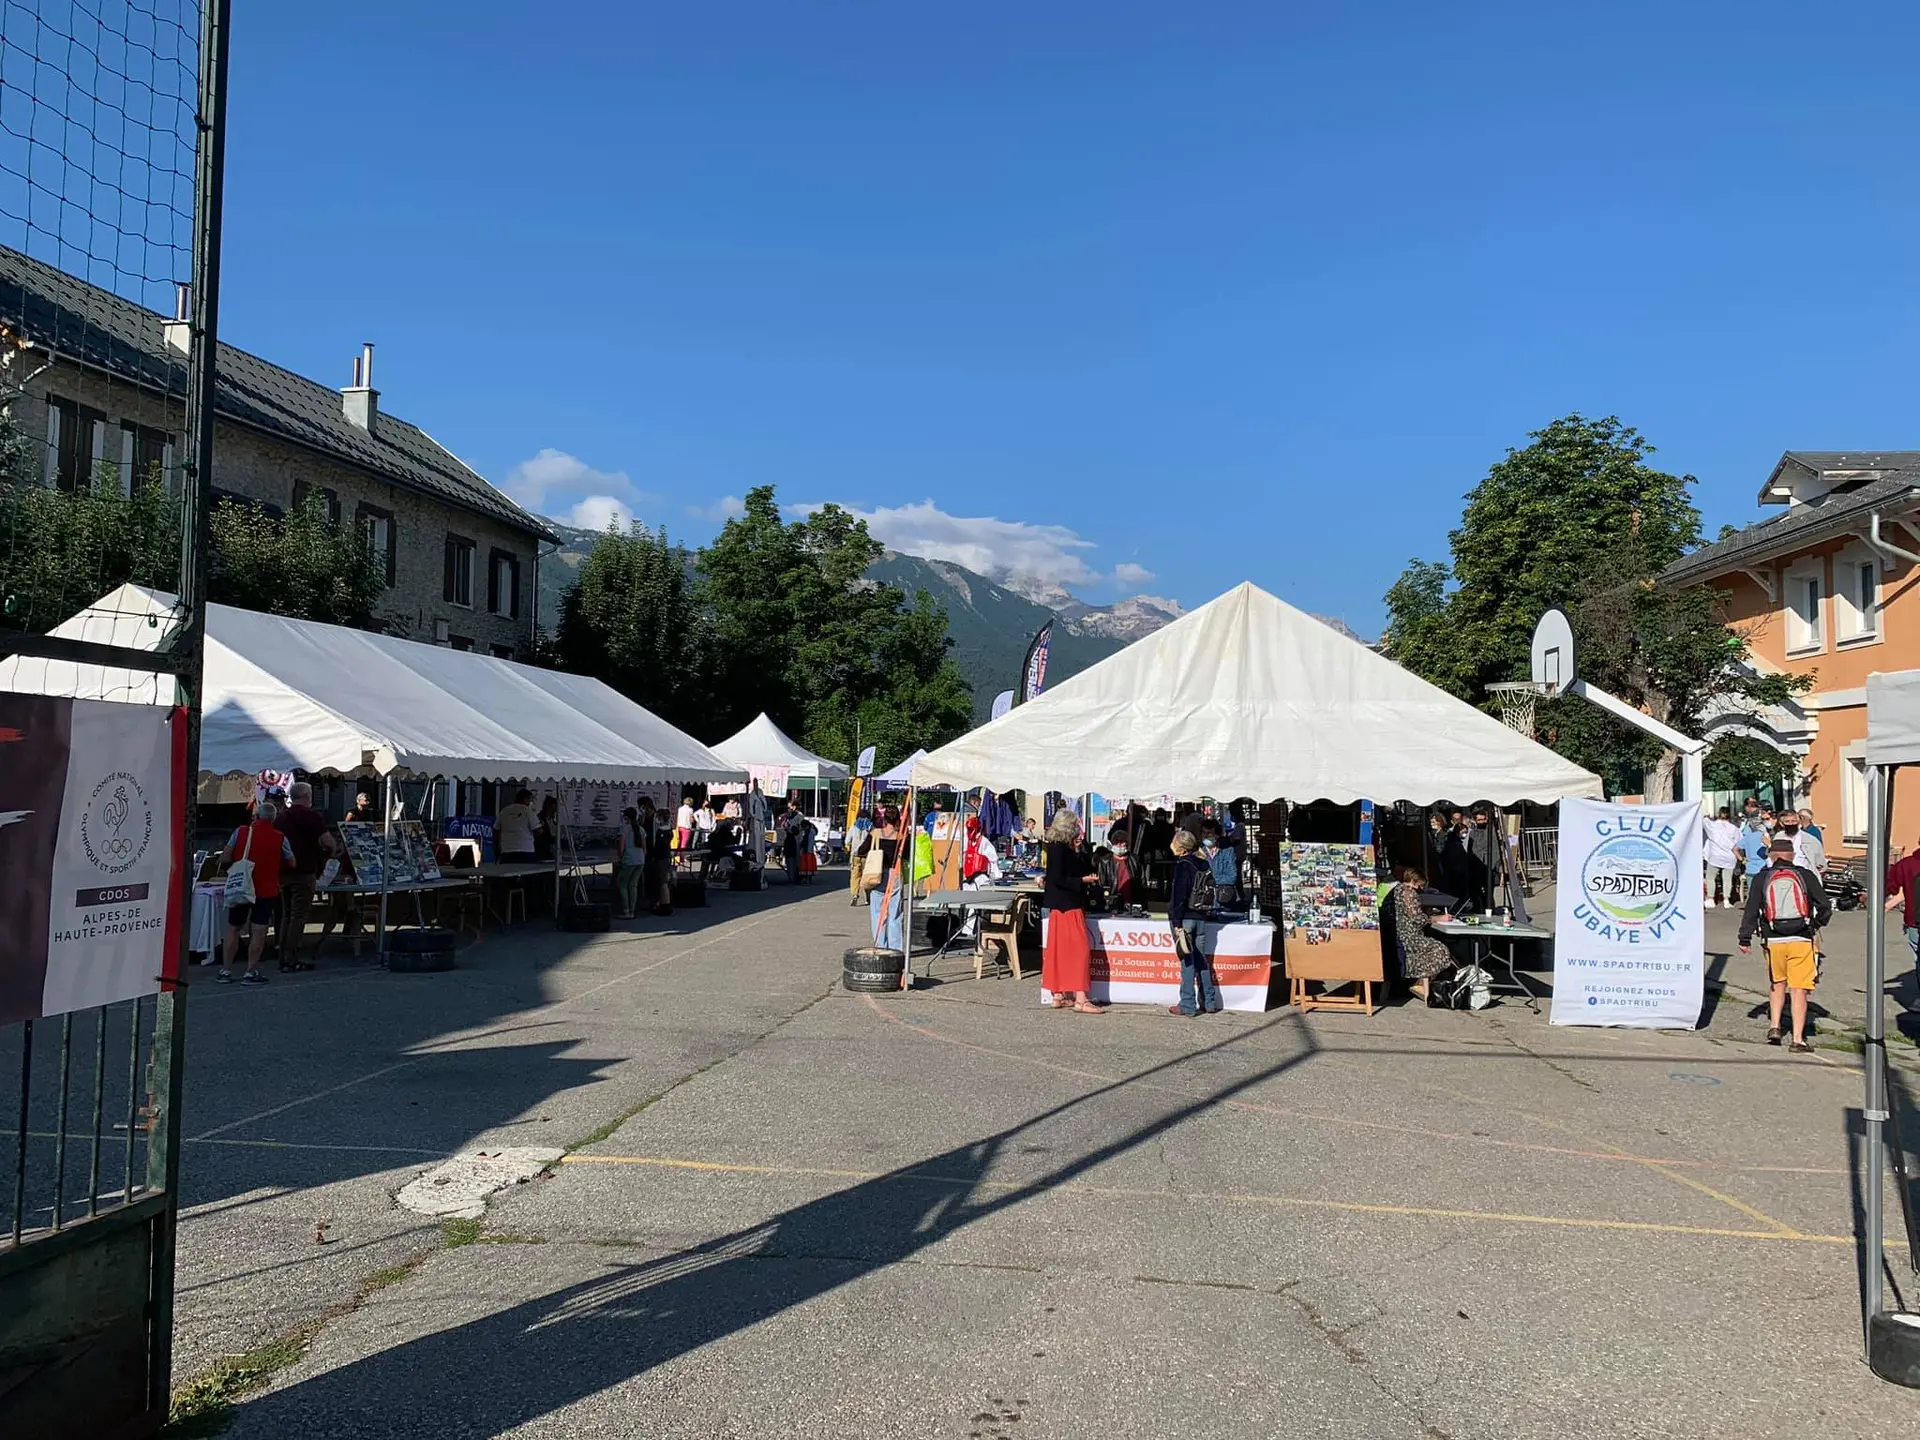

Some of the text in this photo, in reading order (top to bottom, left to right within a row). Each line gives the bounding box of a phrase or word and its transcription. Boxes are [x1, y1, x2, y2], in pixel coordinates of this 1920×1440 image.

[117, 772, 144, 799] NATIONAL
[1595, 816, 1676, 844] CLUB
[81, 813, 100, 867] OLYMPIQUE
[99, 862, 109, 873] ET
[98, 888, 130, 901] CDOS
[1586, 873, 1674, 897] SPADTRIBU
[82, 907, 141, 925] ALPES-DE
[1573, 904, 1687, 943] UBAYE VTT
[54, 917, 162, 943] HAUTE-PROVENCE
[1098, 928, 1173, 948] LA SOUS
[1112, 957, 1123, 966] La
[1125, 958, 1155, 968] Sousta
[1163, 960, 1182, 968] Rés
[1566, 958, 1692, 972] WWW.SPADTRIBU.FR
[1090, 967, 1155, 979] Barcelonnette
[1162, 971, 1173, 979] 04
[1584, 985, 1676, 996] REJOIGNEZ NOUS
[1600, 999, 1658, 1008] SPADTRIBU
